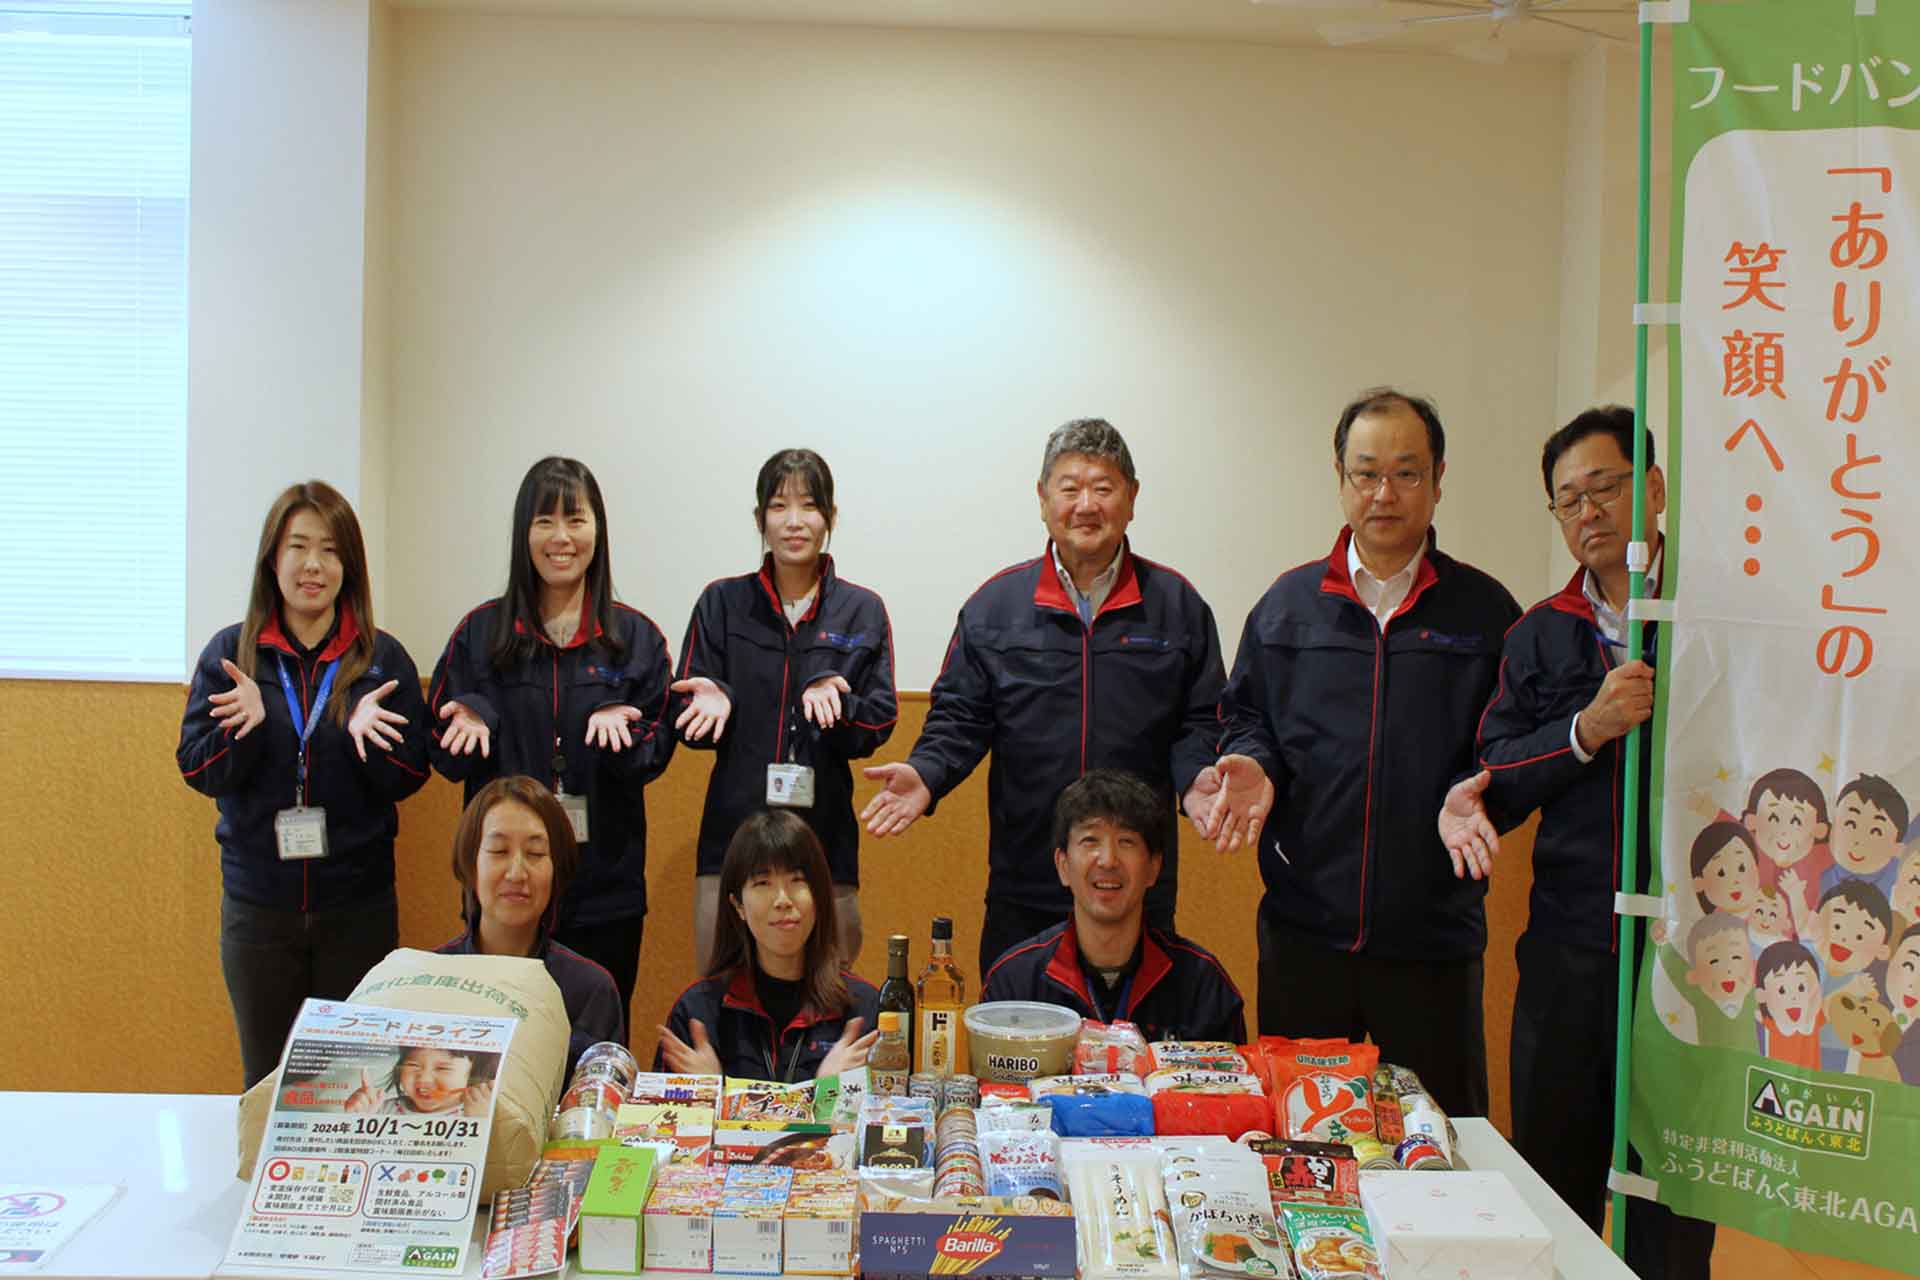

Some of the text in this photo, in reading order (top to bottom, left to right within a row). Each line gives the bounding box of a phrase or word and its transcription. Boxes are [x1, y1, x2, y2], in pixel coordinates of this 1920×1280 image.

[1688, 56, 1920, 112] フードバン
[1815, 166, 1892, 679] 「ありがとう」の
[337, 1016, 492, 1040] フードドライブ
[988, 1054, 1039, 1073] HARIBO
[1752, 1080, 1865, 1133] AGAIN
[311, 1121, 351, 1135] 2024年
[1751, 1115, 1863, 1153] ふうどばんく東北
[1662, 1127, 1801, 1178] 特定非営利活動法人
[871, 1235, 927, 1246] SPAGHETTI
[944, 1237, 996, 1253] Barilla
